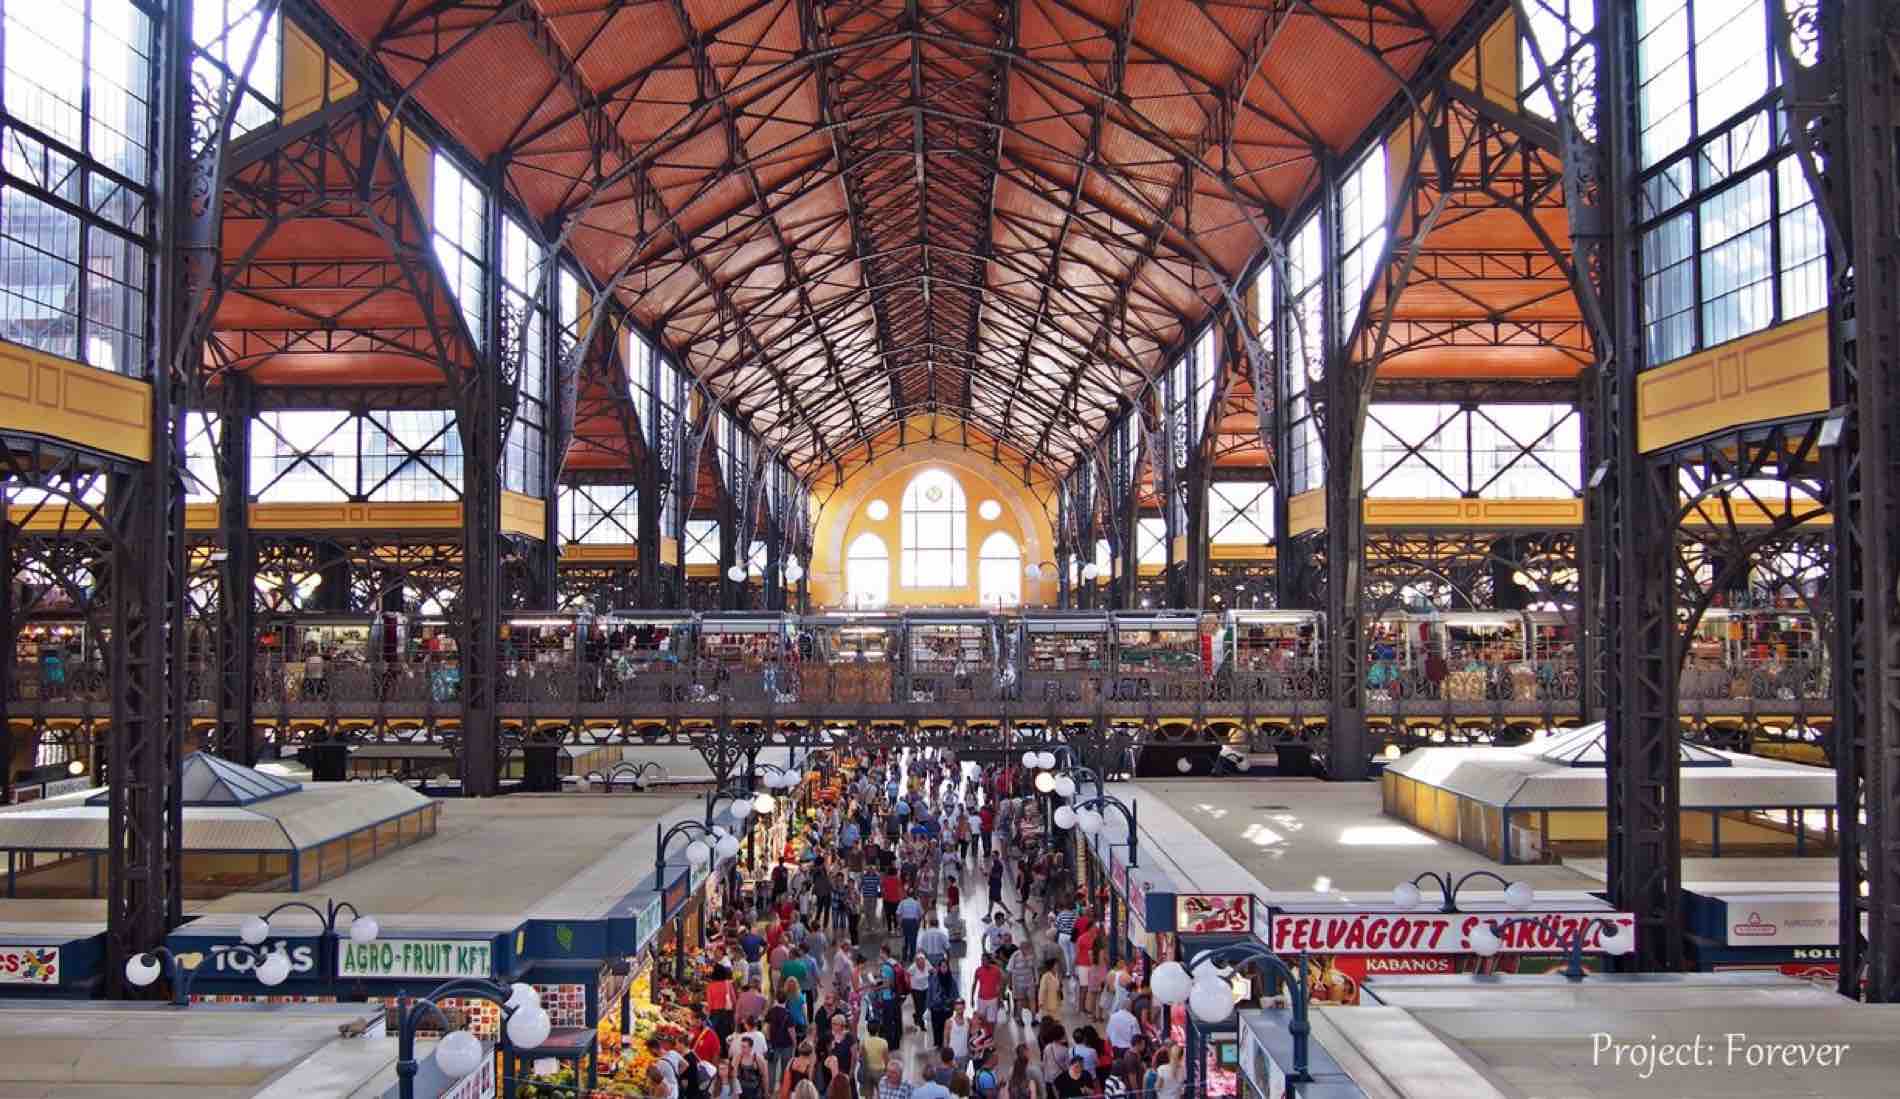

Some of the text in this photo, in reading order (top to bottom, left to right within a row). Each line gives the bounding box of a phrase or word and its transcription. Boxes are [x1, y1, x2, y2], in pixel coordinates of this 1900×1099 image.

[1275, 914, 1633, 950] FELVÁGOTT SAKÜZL
[210, 940, 313, 973] TOÁS
[345, 942, 490, 975] AGRO-FRUIT KFT.
[1366, 958, 1449, 972] KABANOS
[1792, 948, 1840, 959] KOL
